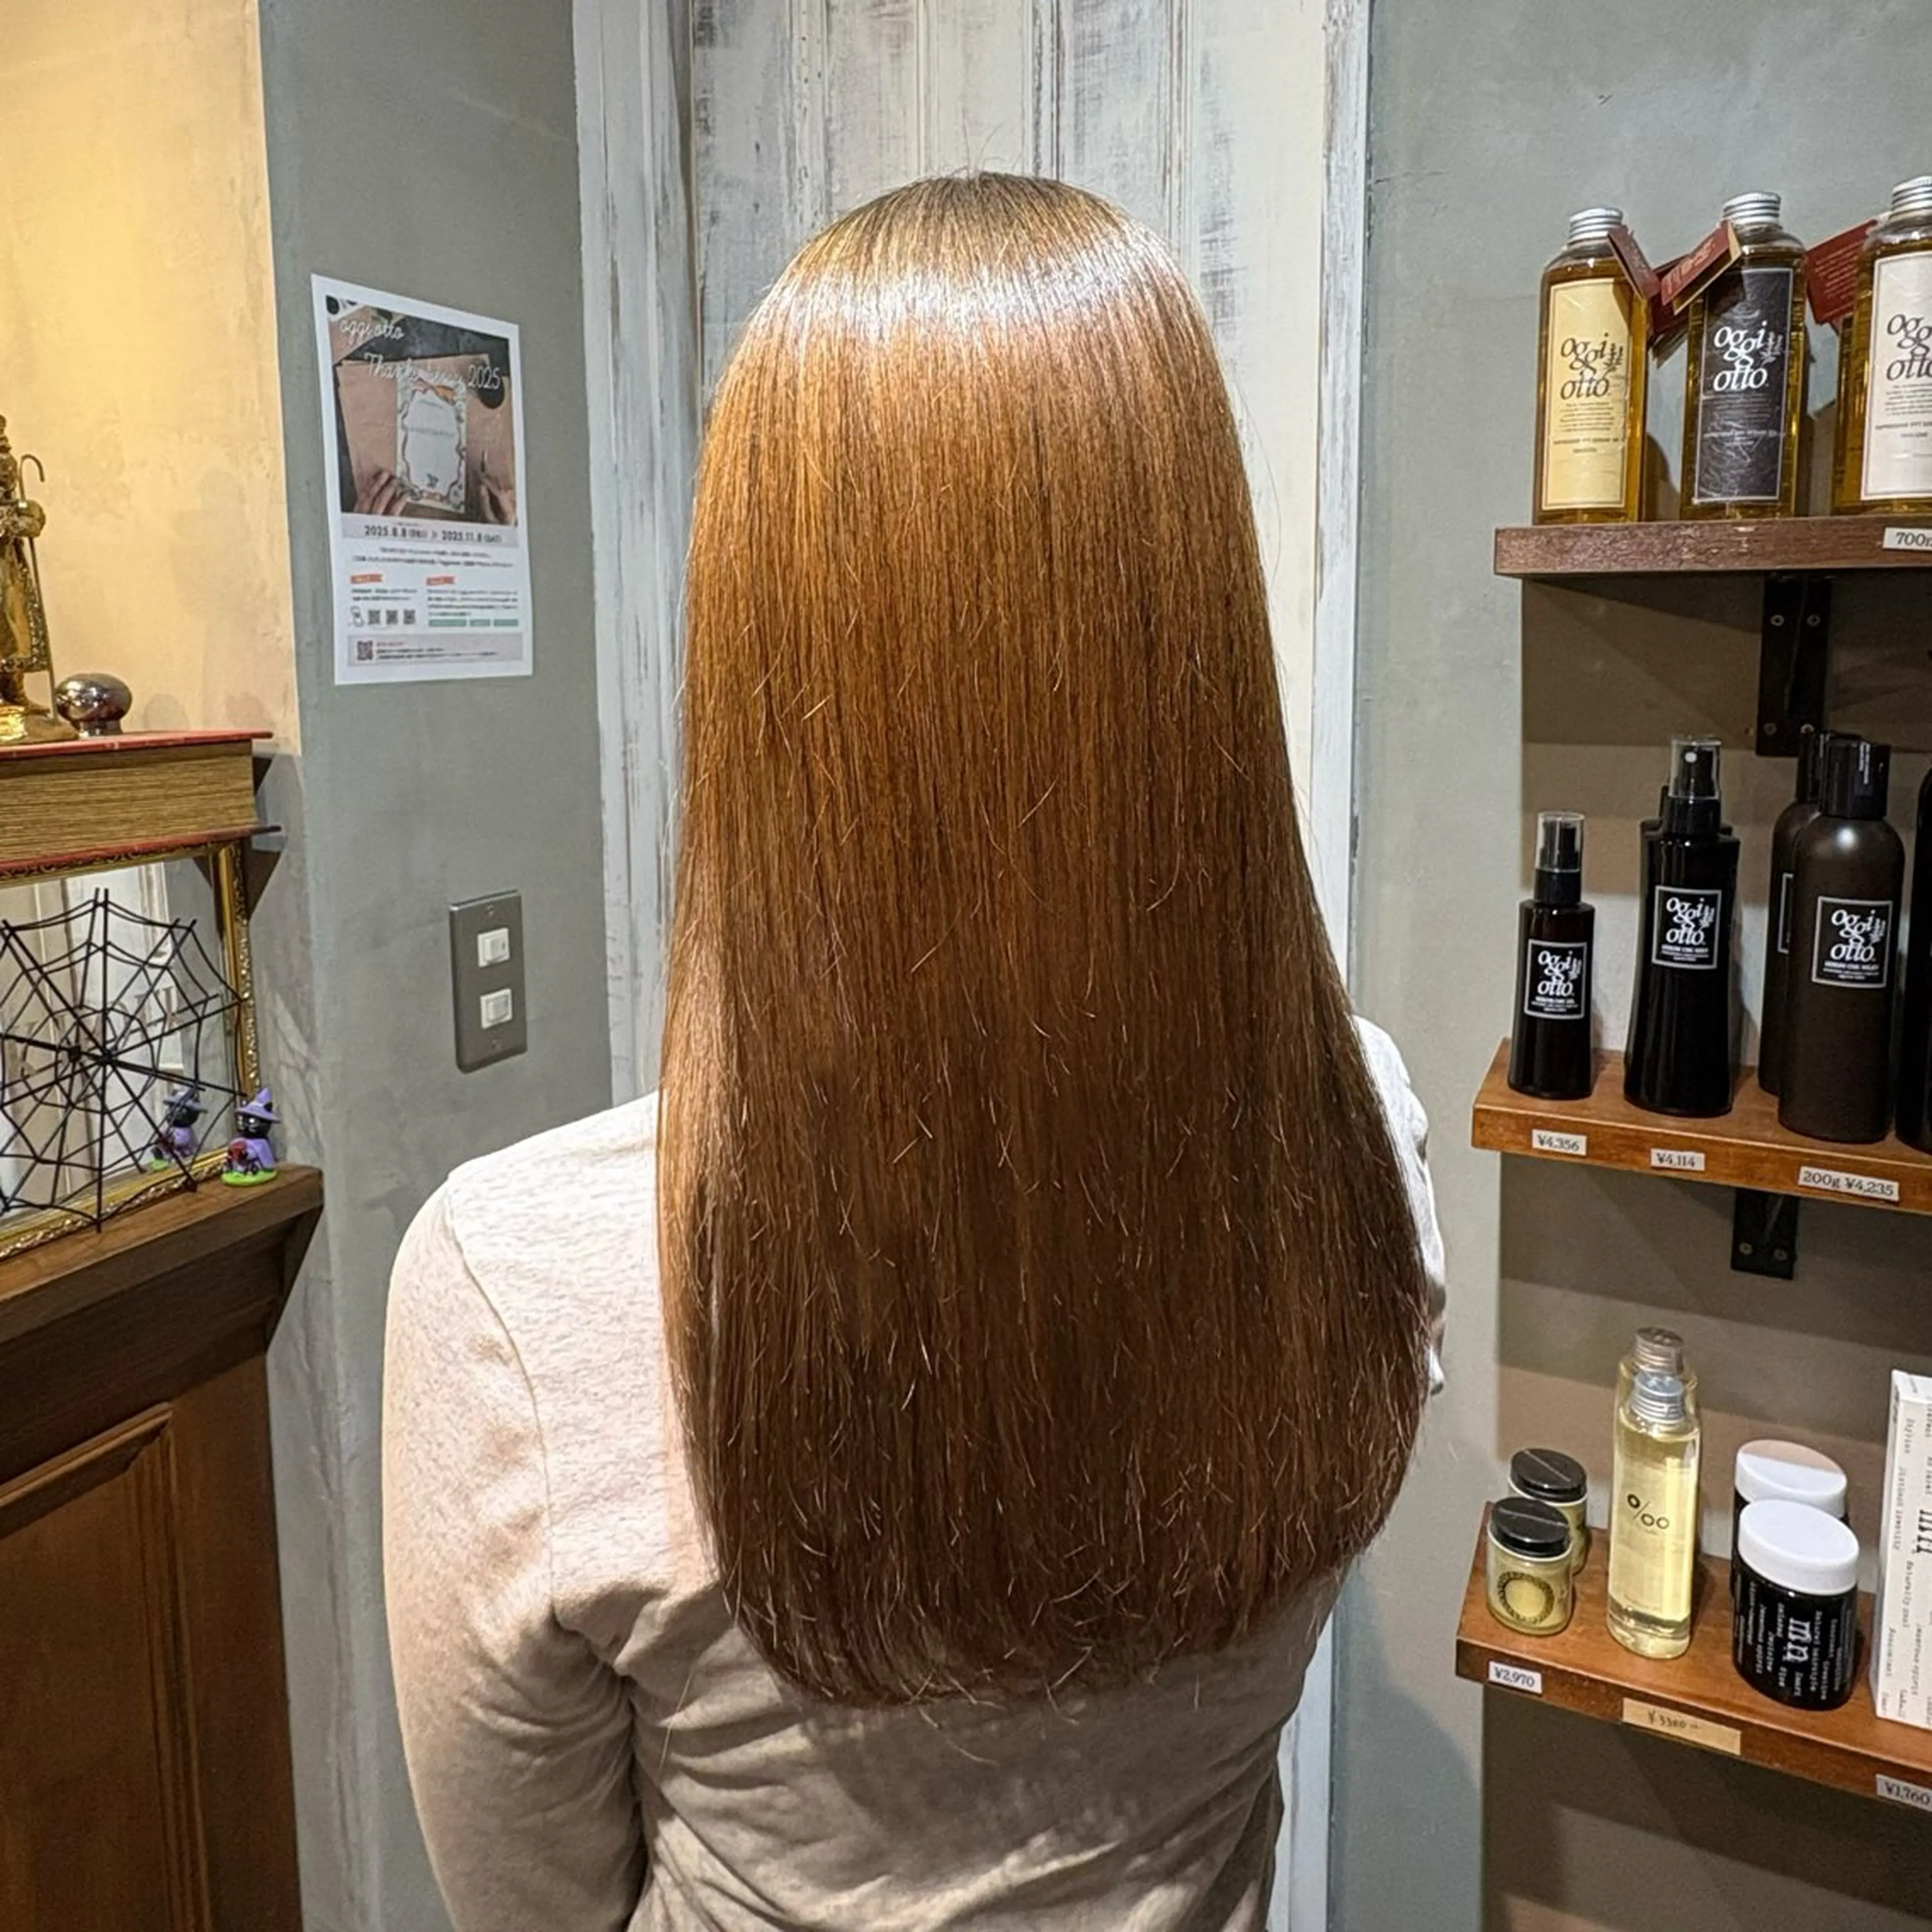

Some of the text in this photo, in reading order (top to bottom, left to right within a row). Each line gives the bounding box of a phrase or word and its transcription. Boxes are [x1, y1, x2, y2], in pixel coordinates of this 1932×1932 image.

[469, 365, 500, 389] 2025
[1537, 1134, 1580, 1152] ¥4,356
[1656, 1152, 1696, 1168] ¥4,114
[1802, 1170, 1894, 1196] 200g ¥4,235
[1494, 1666, 1535, 1687] ¥2,970
